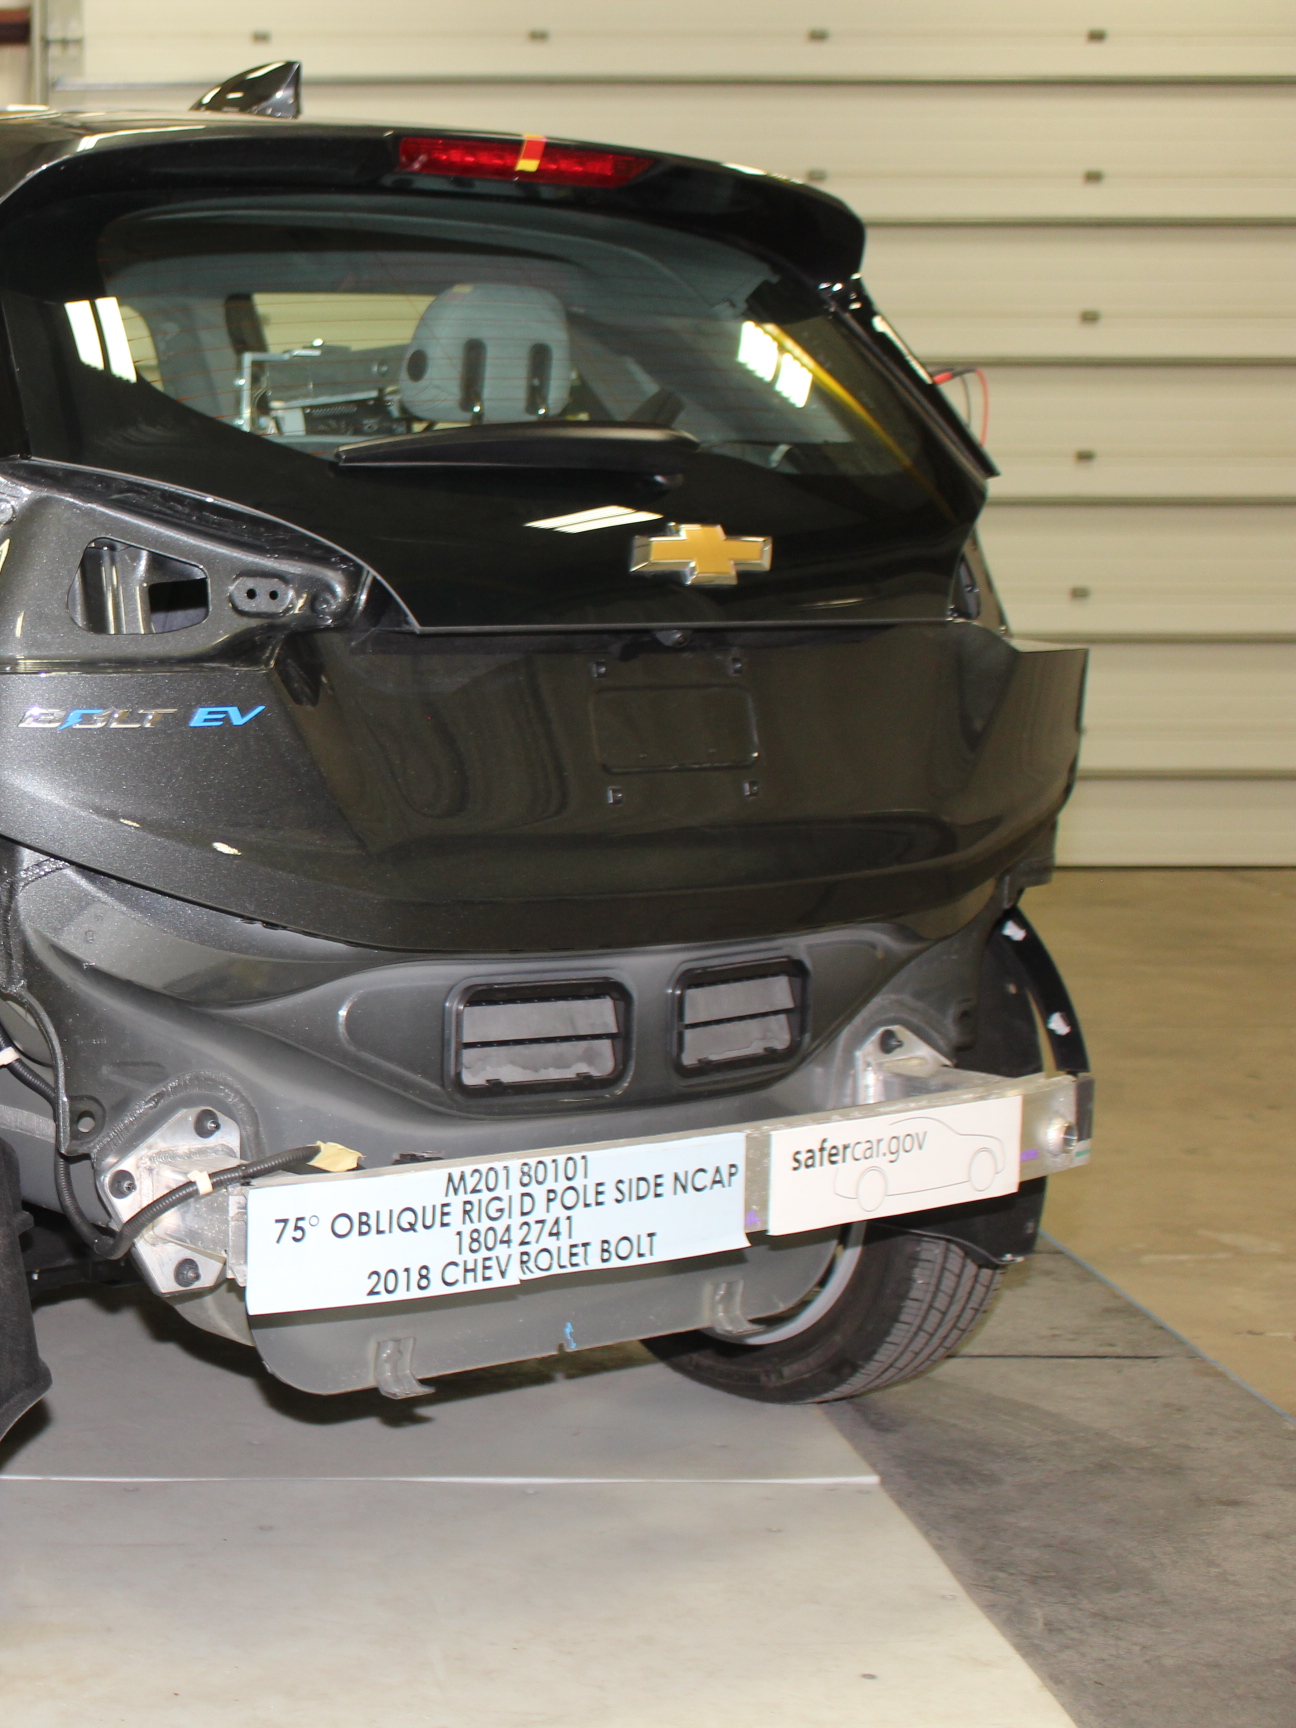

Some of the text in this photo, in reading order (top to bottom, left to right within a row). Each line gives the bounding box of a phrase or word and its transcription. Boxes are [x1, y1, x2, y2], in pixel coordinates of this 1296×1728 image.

[17, 706, 266, 730] BOLT EV
[792, 1131, 928, 1172] safercar.gov
[331, 1202, 452, 1239] OBLIQUE
[462, 1192, 536, 1225] RIGID
[546, 1181, 606, 1213] POLE
[614, 1173, 664, 1204] SIDE
[673, 1163, 739, 1195] NCAP
[366, 1265, 431, 1296] 2018
[600, 1232, 657, 1264] BOLT
